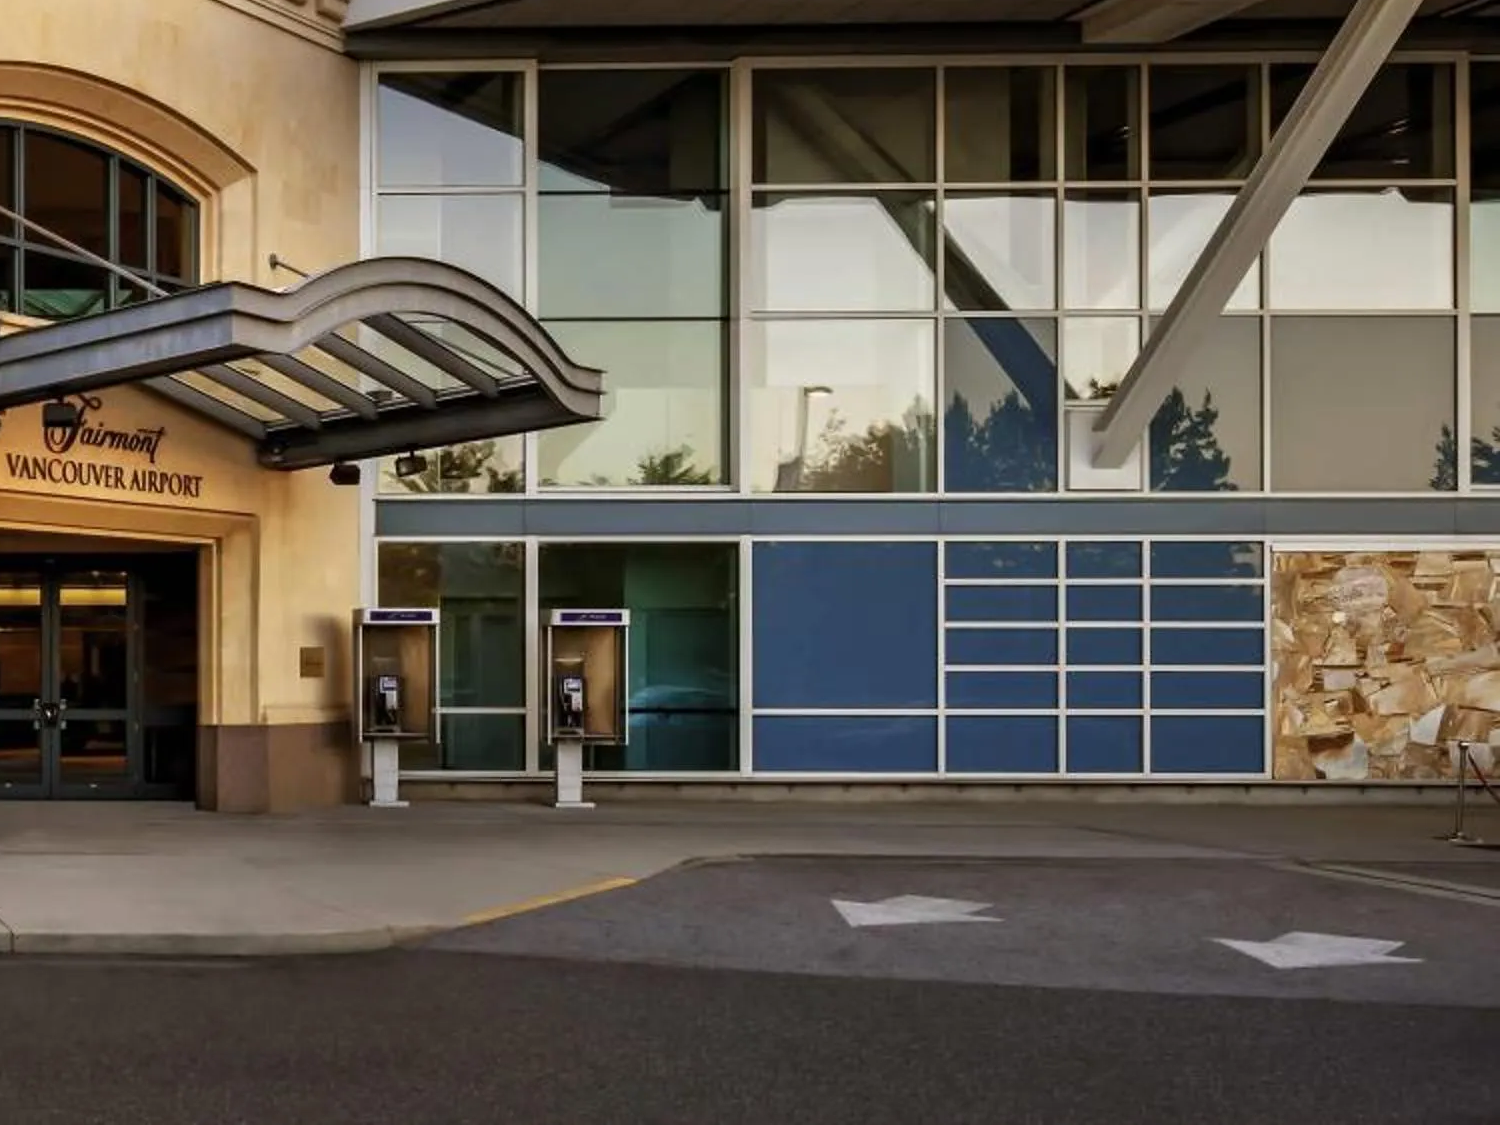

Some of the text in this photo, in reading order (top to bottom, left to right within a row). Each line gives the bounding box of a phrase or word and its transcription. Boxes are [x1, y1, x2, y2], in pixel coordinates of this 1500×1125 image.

[43, 393, 167, 464] Fairmont
[6, 453, 203, 498] VANCOUVER AIRPORT
